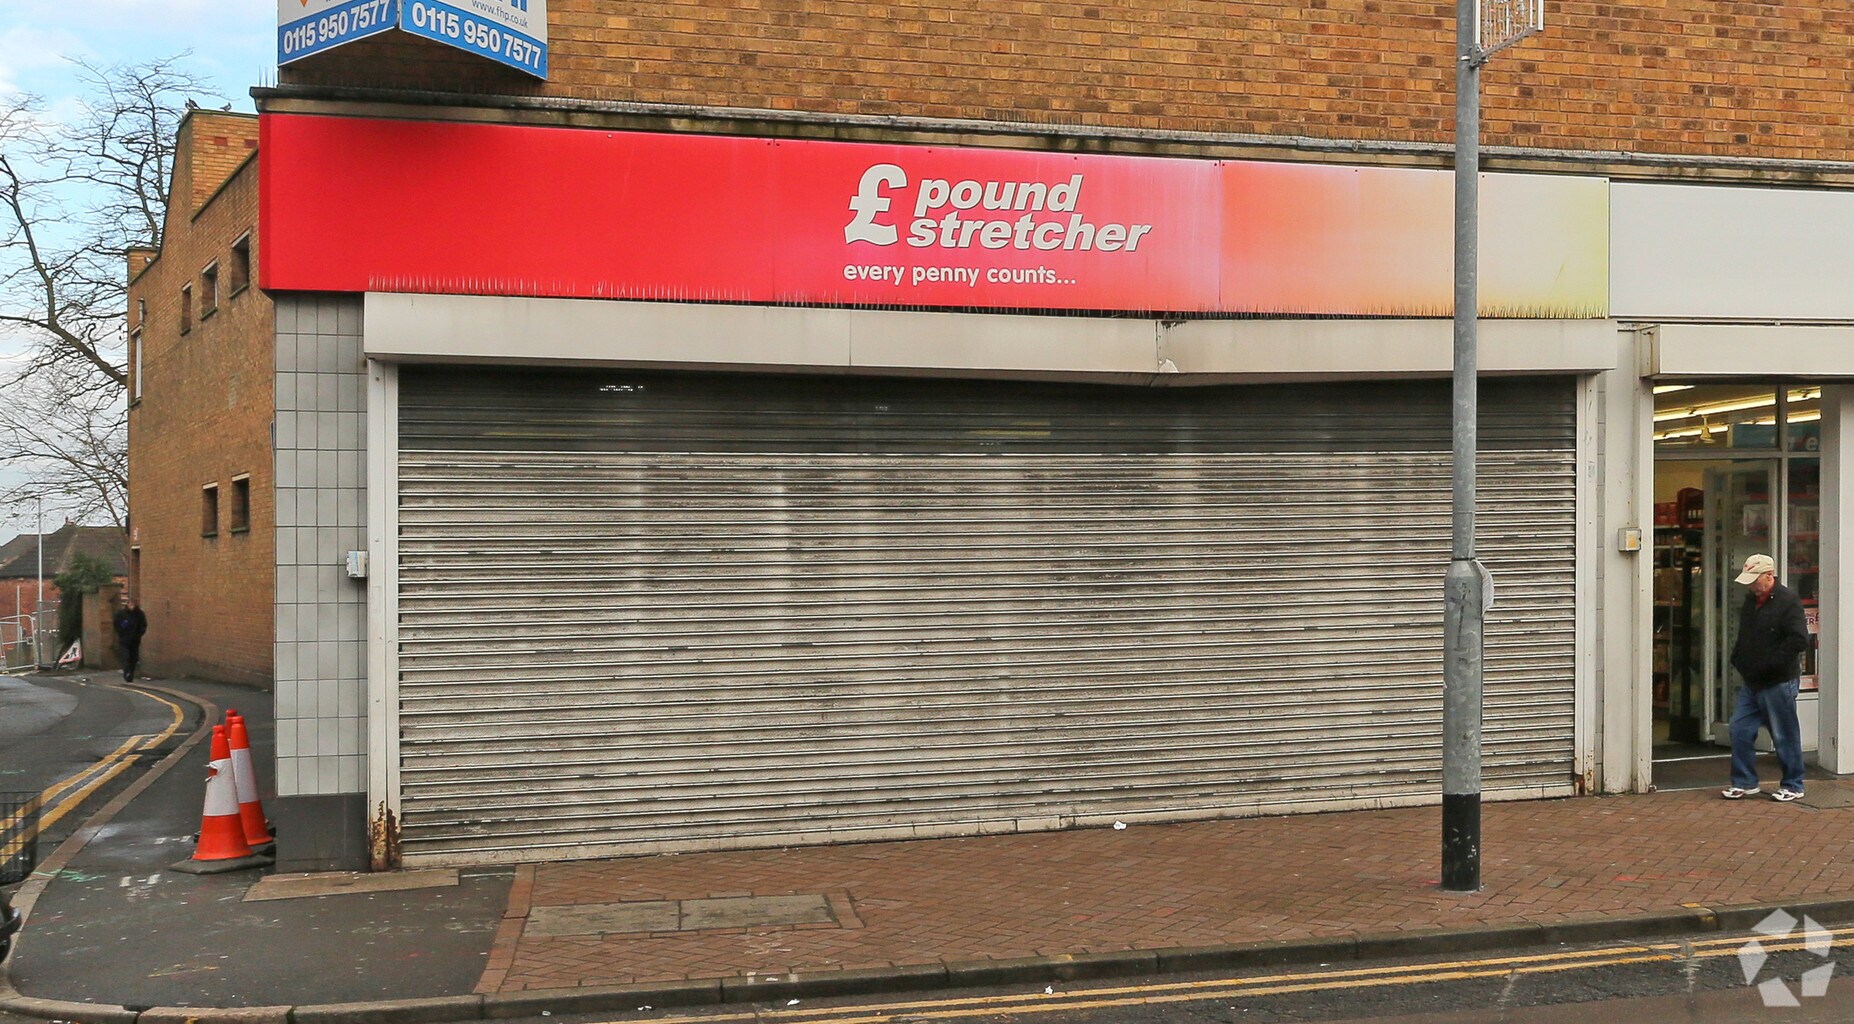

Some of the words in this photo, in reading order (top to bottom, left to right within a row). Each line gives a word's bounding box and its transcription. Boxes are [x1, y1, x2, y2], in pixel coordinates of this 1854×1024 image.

[283, 21, 317, 54] 0115
[318, 10, 349, 43] 950
[411, 1, 461, 39] 0115
[463, 19, 502, 53] 950
[503, 33, 542, 70] 7577
[844, 163, 908, 246] £
[913, 174, 1084, 217] pound
[906, 211, 1153, 252] stretcher
[843, 264, 905, 286] every
[912, 265, 980, 287] penny
[986, 265, 1077, 285] counts...
